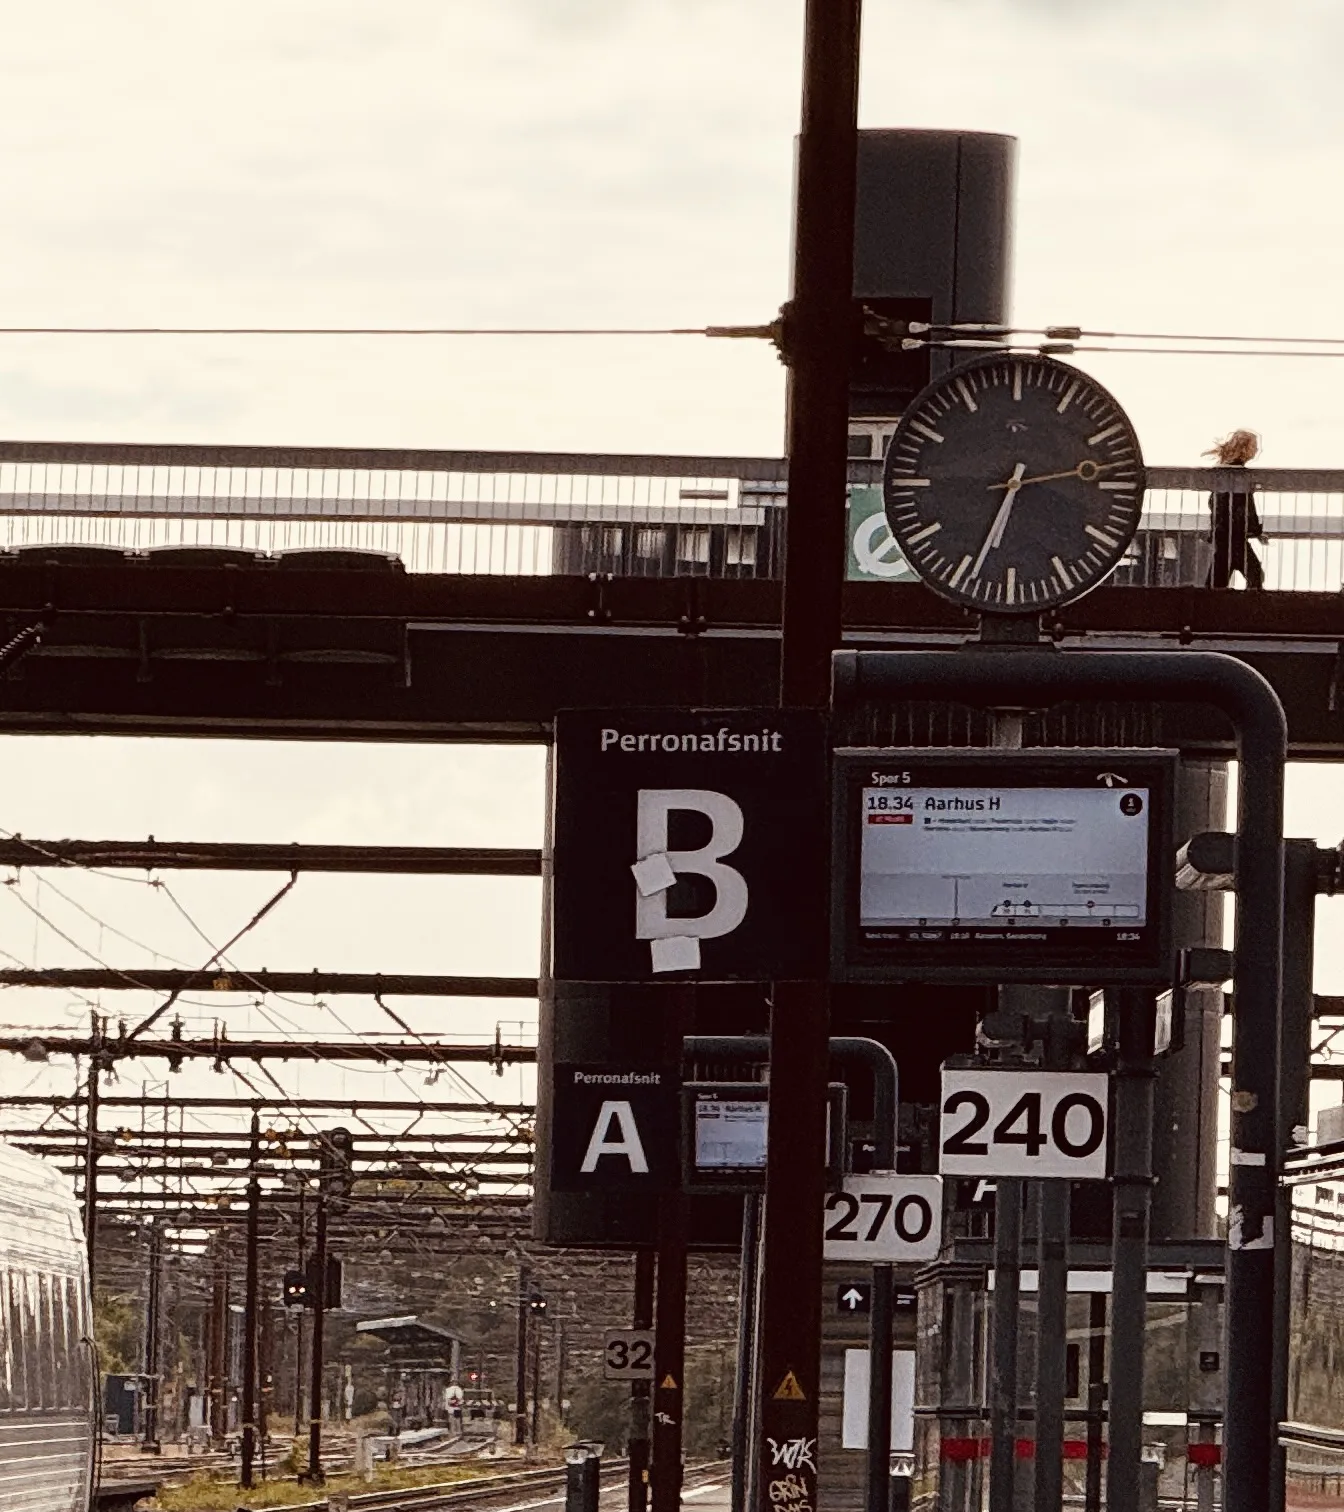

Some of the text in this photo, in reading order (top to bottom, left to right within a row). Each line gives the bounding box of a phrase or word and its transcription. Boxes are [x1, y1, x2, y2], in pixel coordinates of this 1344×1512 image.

[600, 728, 783, 752] Perronafsnit
[902, 772, 911, 784] 5
[867, 796, 1001, 811] 18.34 Aarhus H
[635, 788, 749, 940] B
[573, 1071, 661, 1085] Perronafsnit
[580, 1100, 649, 1173] A
[943, 1090, 1105, 1158] 240
[824, 1192, 932, 1243] 270
[607, 1340, 652, 1370] 32
